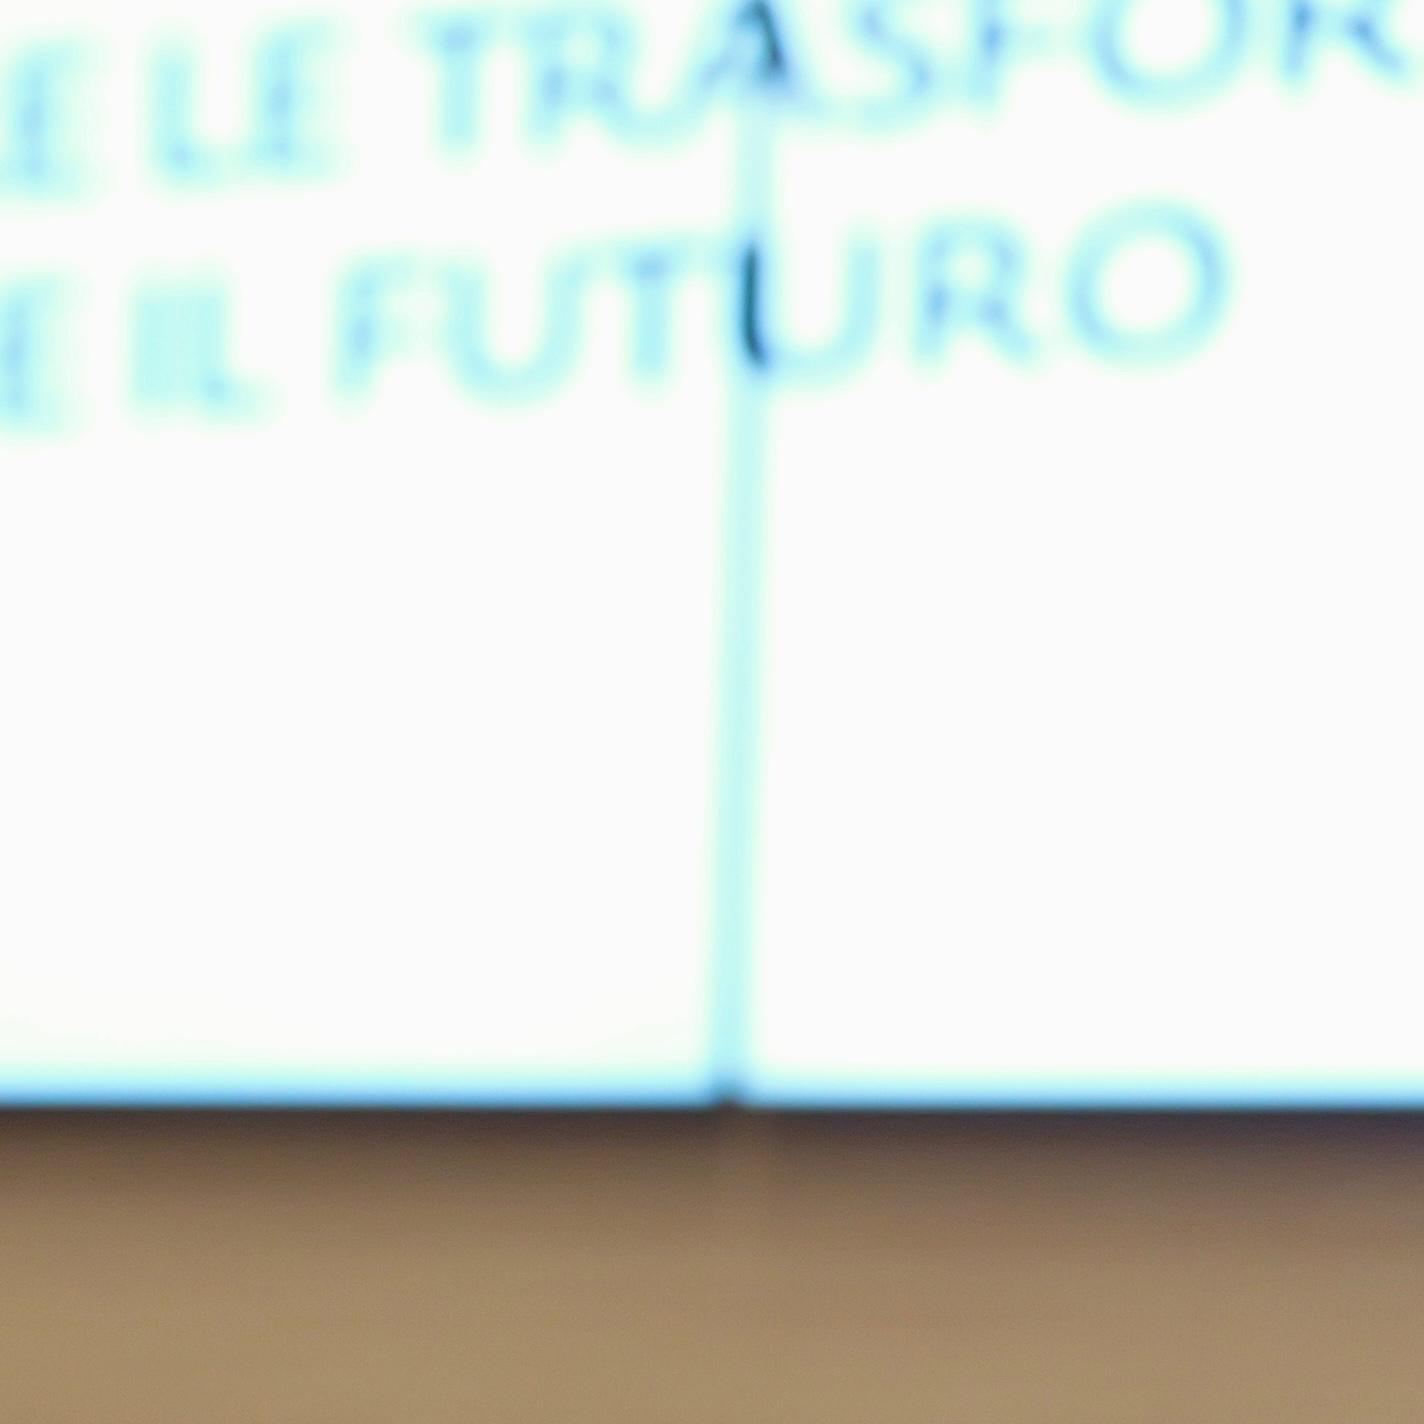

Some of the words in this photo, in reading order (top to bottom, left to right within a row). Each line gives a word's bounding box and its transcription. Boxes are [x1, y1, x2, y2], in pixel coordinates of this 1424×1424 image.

[144, 22, 340, 186] LE
[126, 265, 278, 428] IL
[332, 200, 1236, 408] FUTURO
